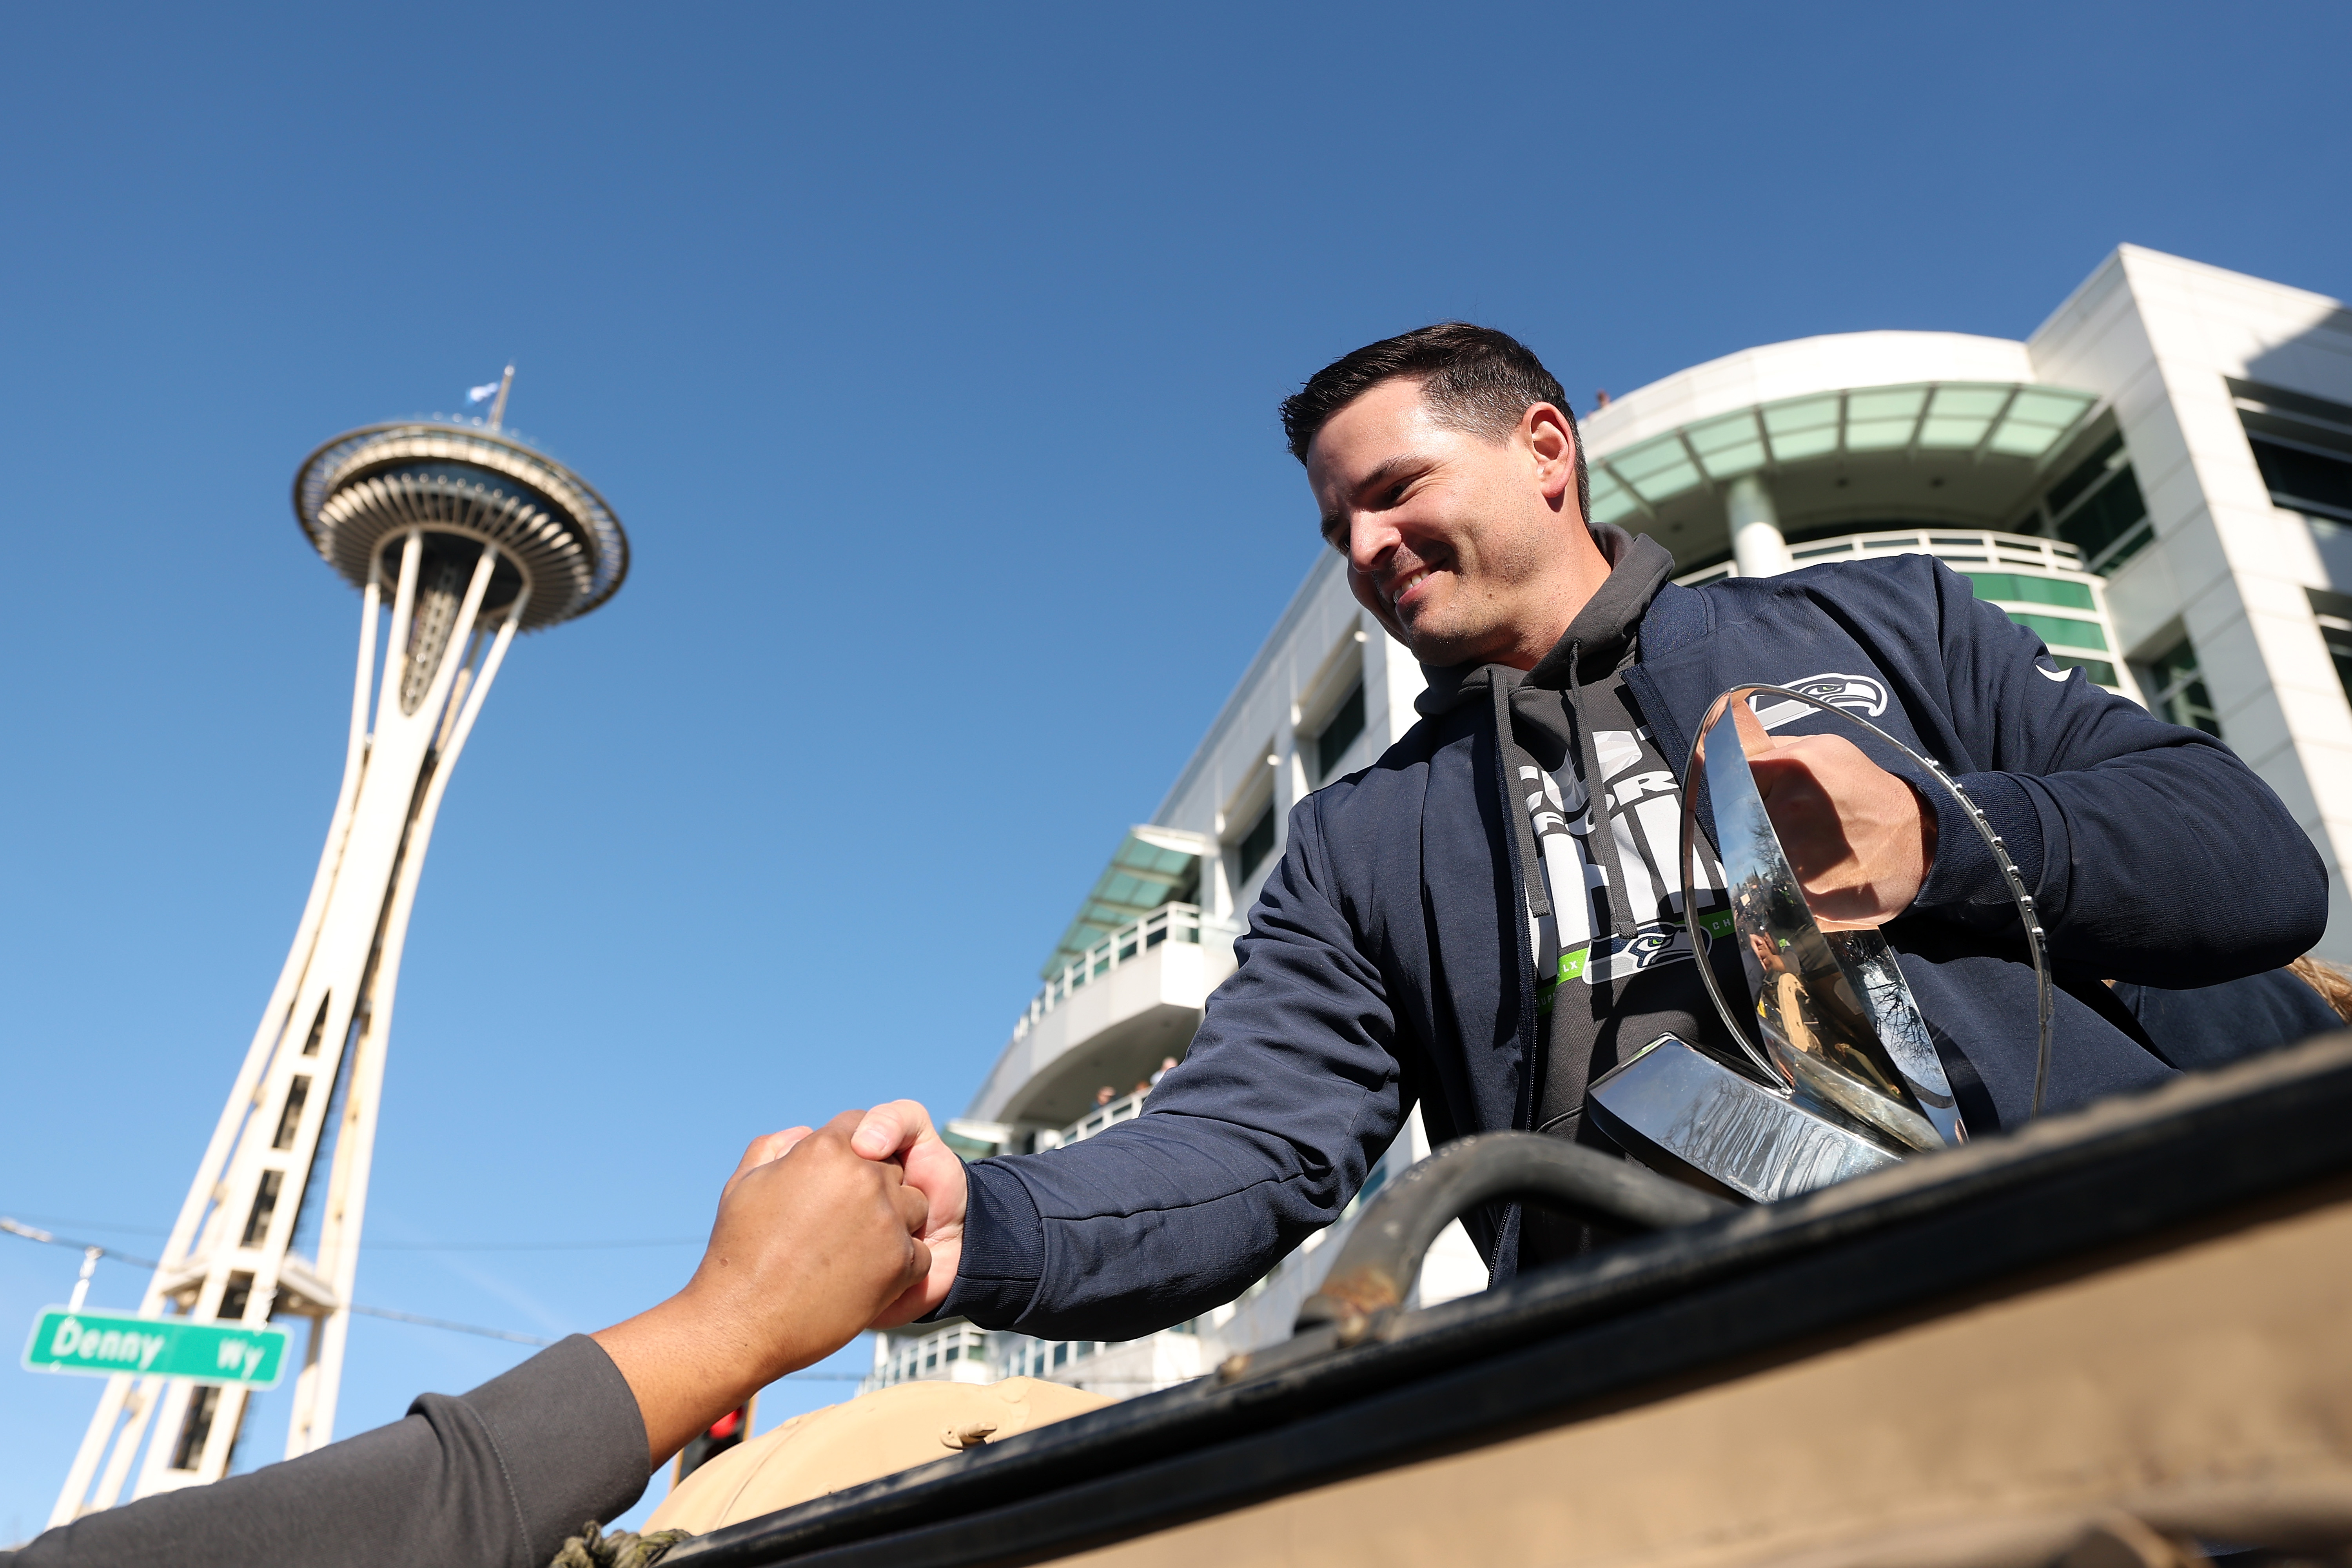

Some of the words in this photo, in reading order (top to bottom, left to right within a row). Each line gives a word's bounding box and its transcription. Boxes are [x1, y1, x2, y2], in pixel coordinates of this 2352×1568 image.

[1712, 918, 1731, 930] CH
[1563, 960, 1578, 972] LX
[51, 1320, 163, 1370] Denny
[217, 1336, 265, 1380] Wy
